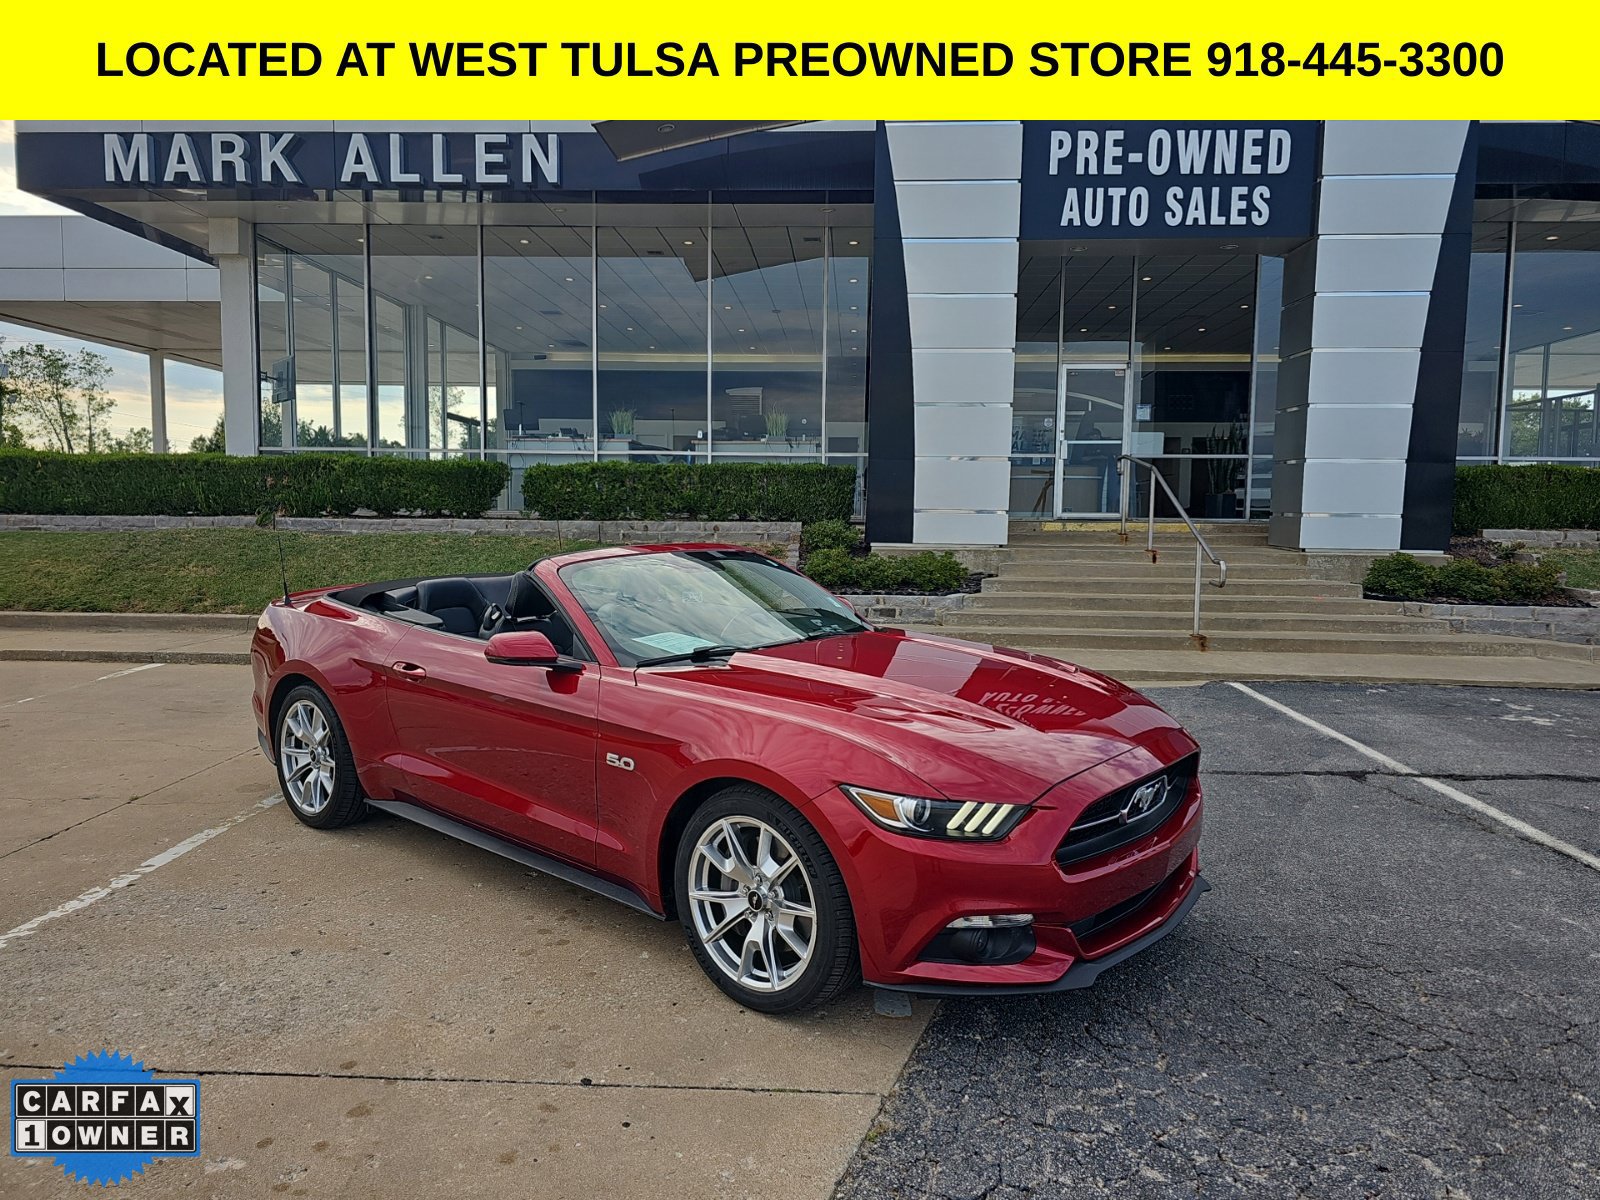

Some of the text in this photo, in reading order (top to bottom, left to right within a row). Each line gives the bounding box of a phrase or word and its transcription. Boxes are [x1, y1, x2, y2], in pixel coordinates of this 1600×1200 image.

[104, 133, 561, 186] MARK ALLEN
[1049, 129, 1292, 175] PRE-OWNED
[1060, 185, 1270, 226] AUTO SALES
